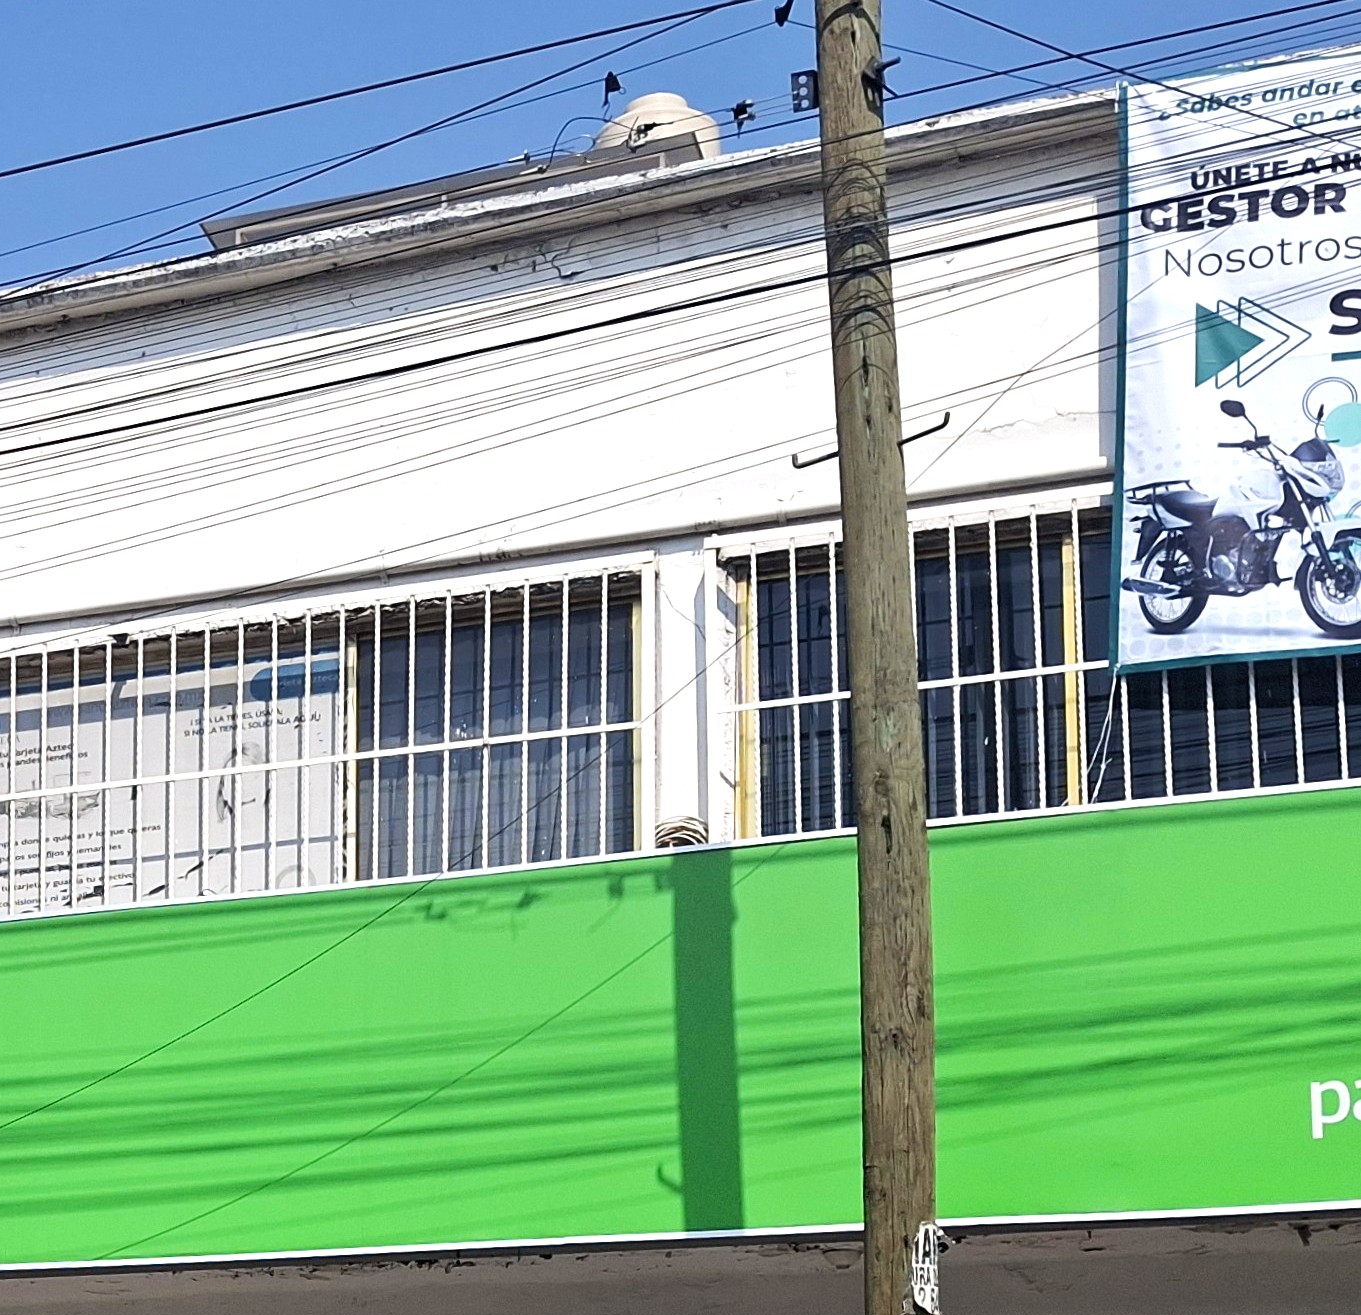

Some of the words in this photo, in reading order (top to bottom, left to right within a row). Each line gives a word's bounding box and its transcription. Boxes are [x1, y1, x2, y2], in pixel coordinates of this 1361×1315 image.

[1261, 79, 1343, 103] andar
[1293, 110, 1325, 127] en
[1190, 163, 1289, 191] ÚNETE
[1140, 182, 1347, 233] GESTOR
[1164, 236, 1361, 278] Nosotros
